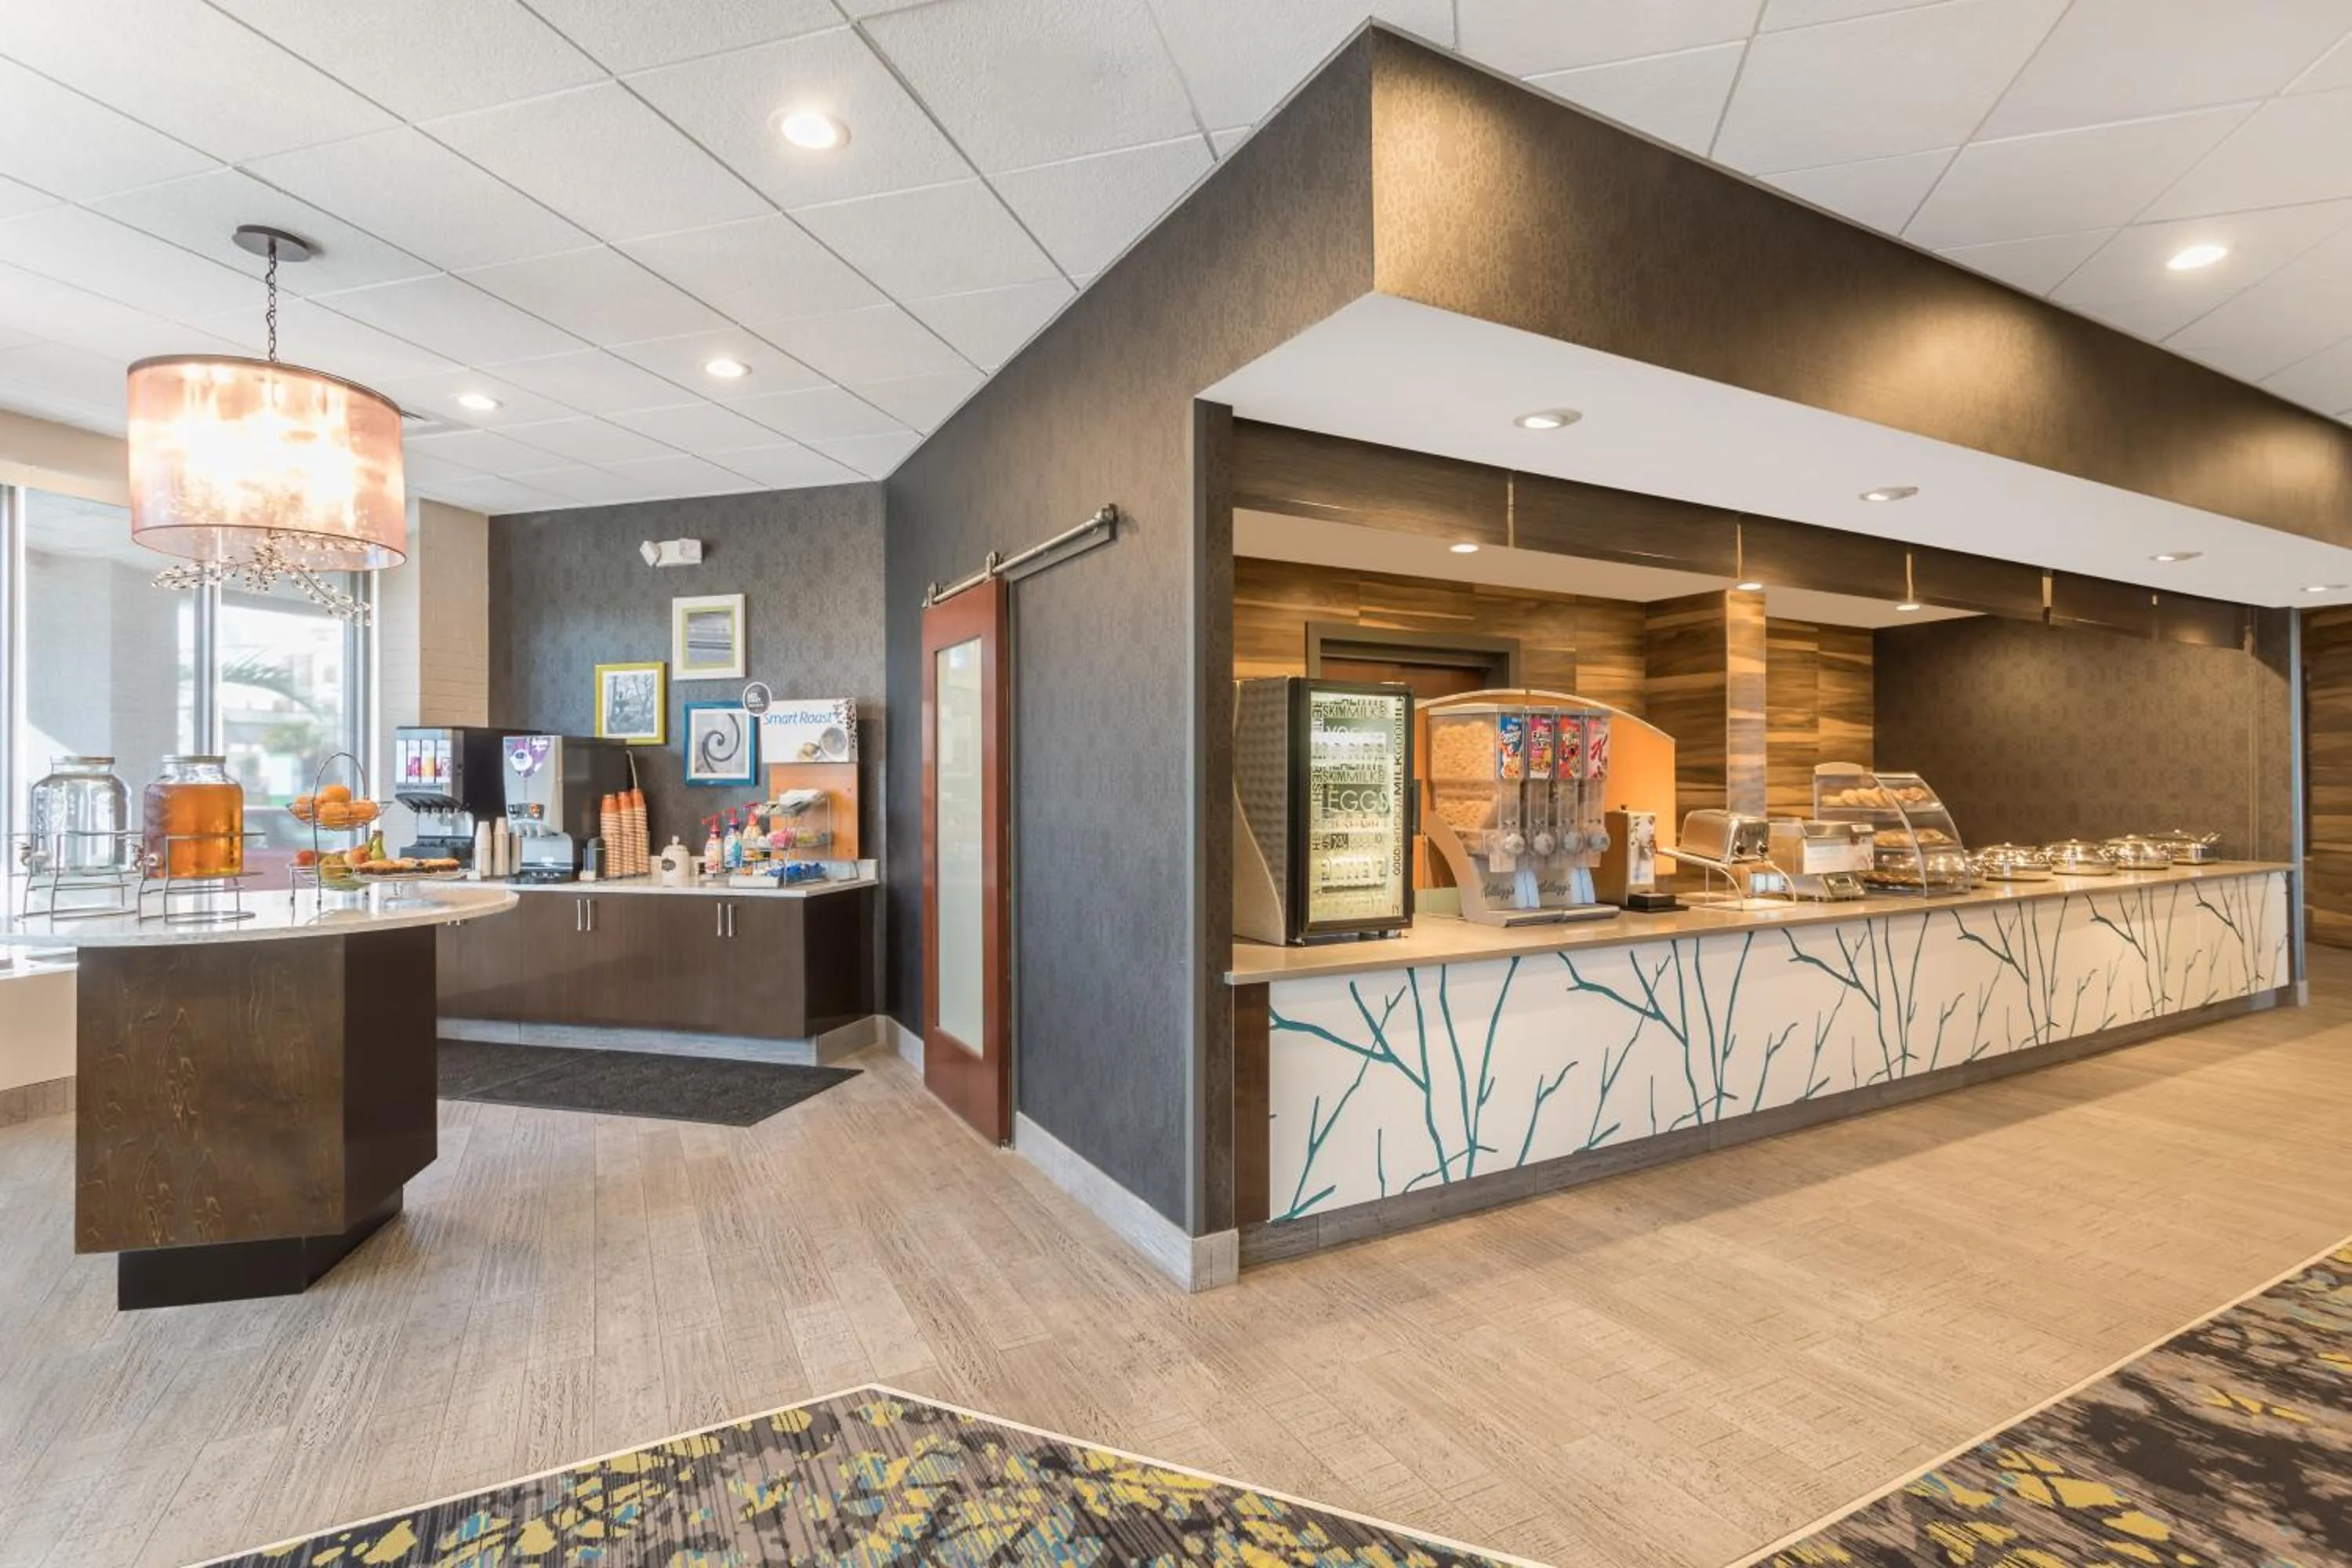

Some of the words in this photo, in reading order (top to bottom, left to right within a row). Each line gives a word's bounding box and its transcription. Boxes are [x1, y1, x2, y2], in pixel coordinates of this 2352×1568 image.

[763, 711, 798, 725] Smart
[800, 711, 833, 724] Roast
[1327, 789, 1389, 813] EGGS
